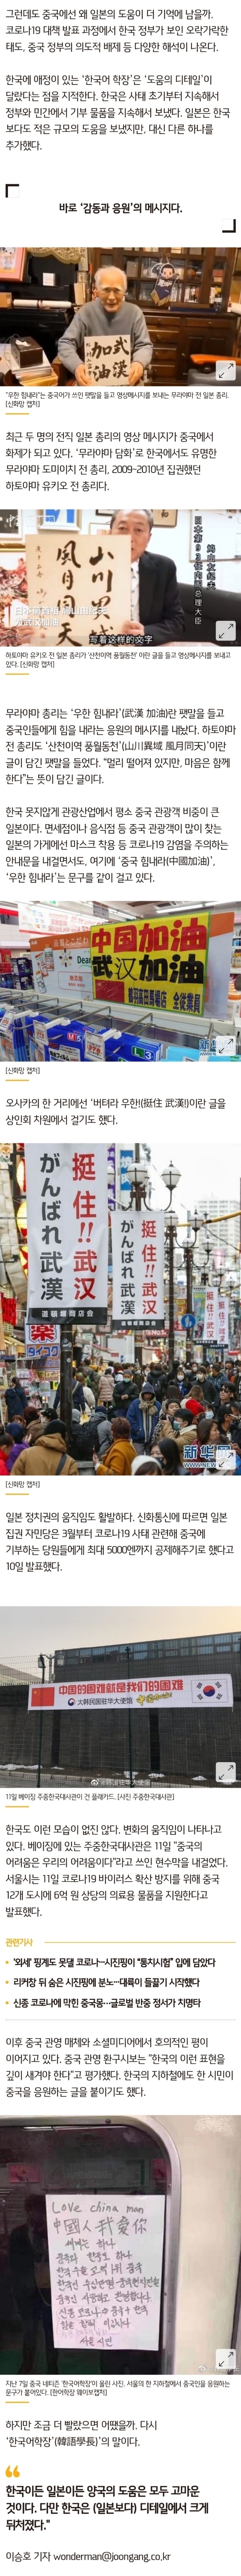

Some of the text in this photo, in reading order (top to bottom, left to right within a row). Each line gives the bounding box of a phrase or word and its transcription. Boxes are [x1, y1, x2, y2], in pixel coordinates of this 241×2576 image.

[91, 918, 207, 953] 中国加油
[92, 954, 204, 984] 武汉加油
[128, 987, 200, 1014] 鶴羽高田馬場店 全従業員
[88, 1045, 100, 1053] 378
[134, 1048, 152, 1059] L 3
[50, 1050, 70, 1061] 防水フィルム
[28, 1346, 59, 1357] ダイコク
[59, 1679, 183, 1695] 中国的困难就是我们的困难
[77, 1697, 133, 1705] 大韩民国驻华大使馆
[90, 2201, 118, 2212] china
[127, 2205, 144, 2214] man
[65, 2238, 116, 2250] 세계는 하나
[56, 2253, 78, 2264] 중국과
[115, 2250, 133, 2261] 하나
[126, 2262, 143, 2274] 중국
[57, 2280, 78, 2291] 한국인
[56, 2294, 77, 2305] 중국인
[59, 2307, 75, 2319] 신종
[80, 2336, 113, 2347] 서울 시민
